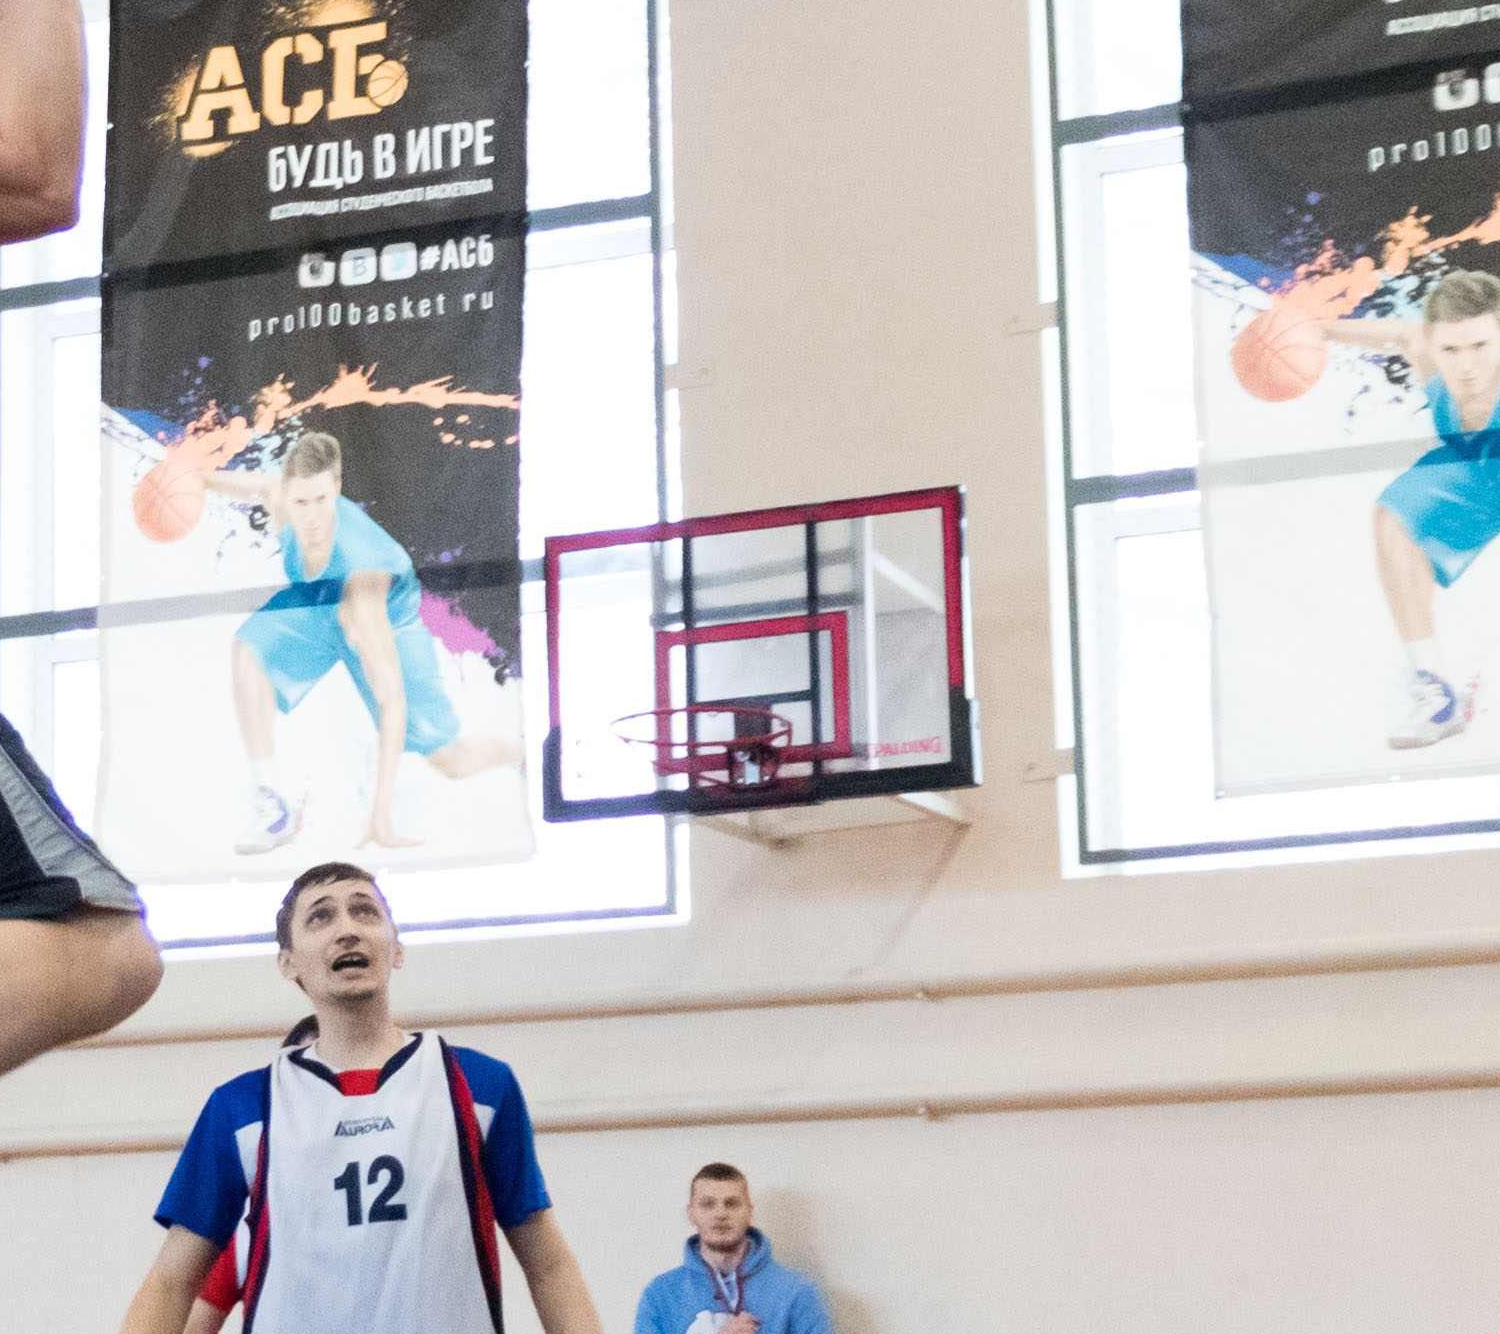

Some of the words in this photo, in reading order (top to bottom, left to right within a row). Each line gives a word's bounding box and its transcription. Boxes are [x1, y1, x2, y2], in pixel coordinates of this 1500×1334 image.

[182, 21, 408, 141] АСБ
[373, 133, 395, 179] В
[406, 119, 494, 174] ИГРЕ
[334, 1154, 408, 1227] 12
